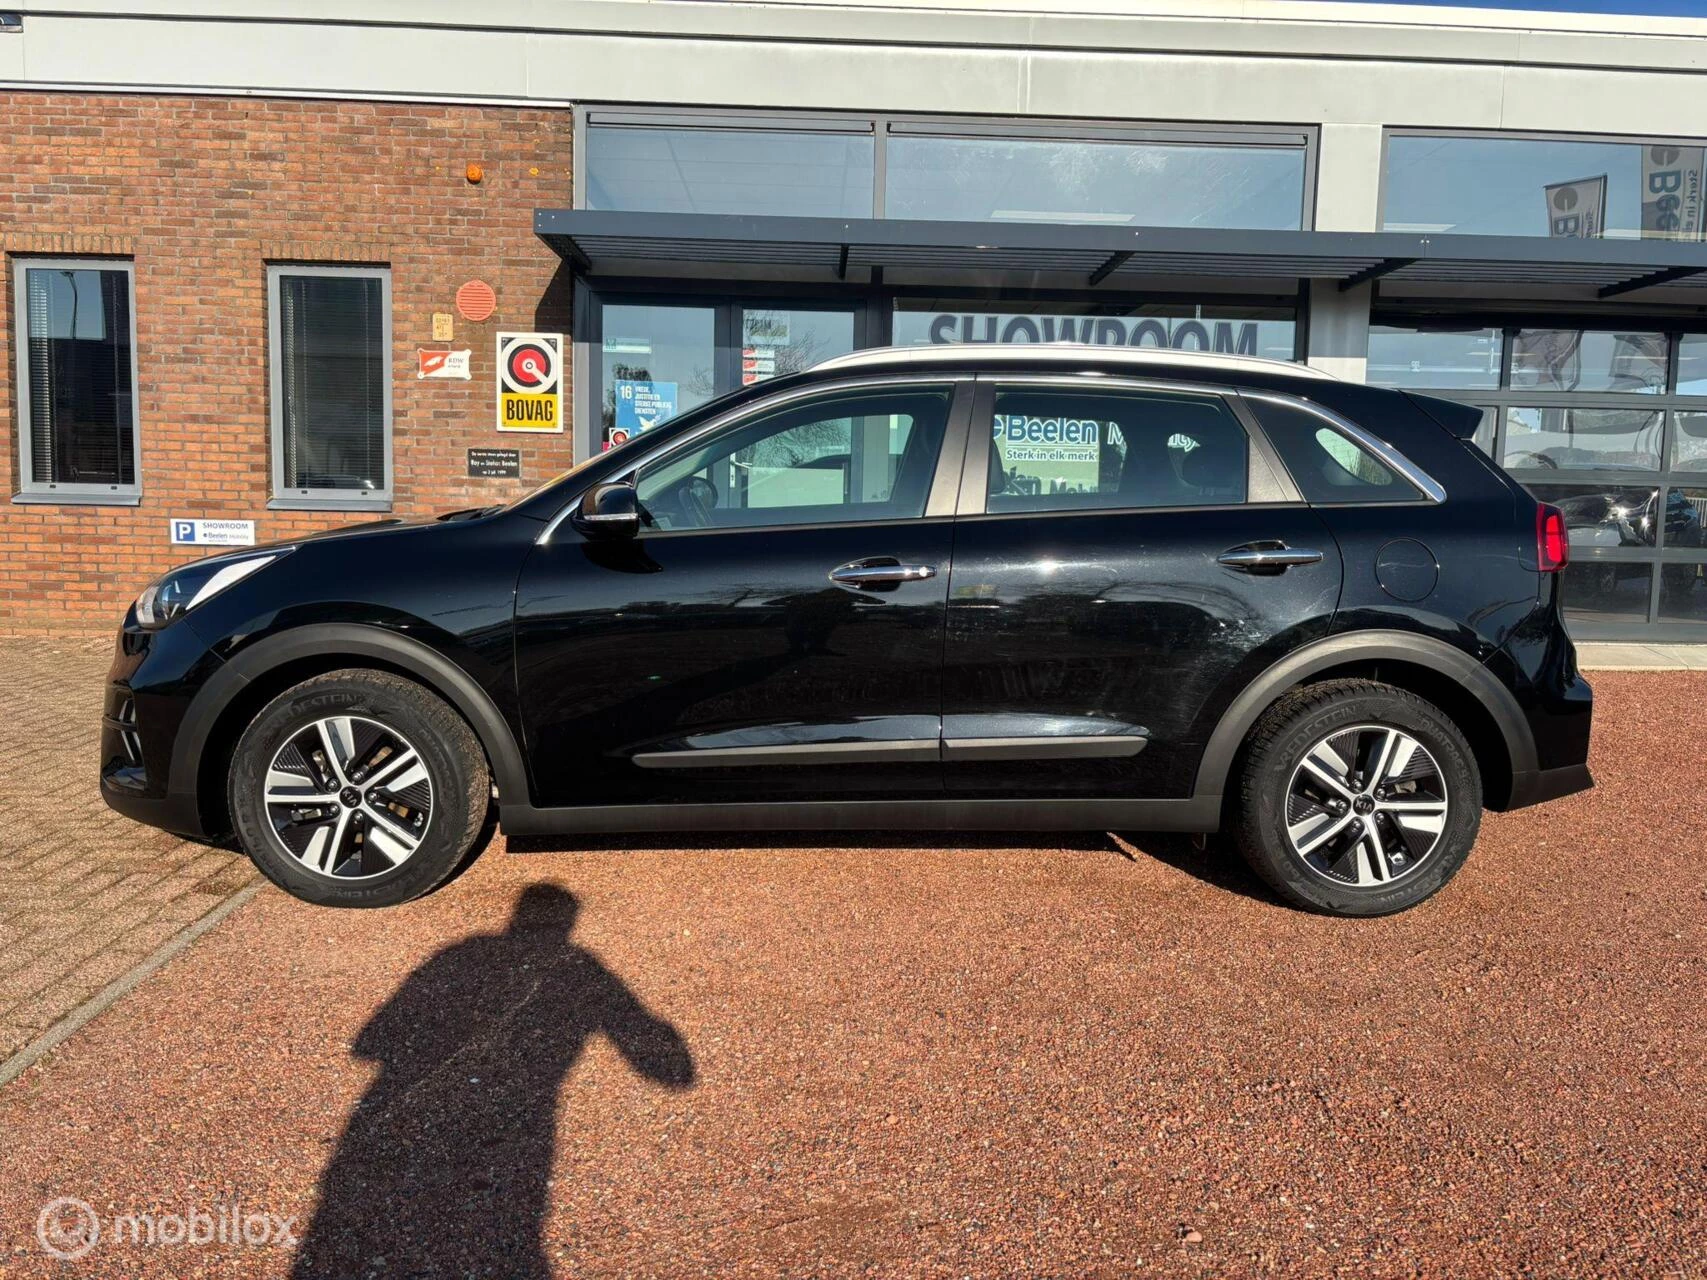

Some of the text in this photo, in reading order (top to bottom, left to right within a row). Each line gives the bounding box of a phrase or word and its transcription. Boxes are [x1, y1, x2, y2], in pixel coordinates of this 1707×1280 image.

[928, 313, 1258, 356] SHOWROOM
[620, 385, 632, 399] 16
[506, 399, 553, 421] BOVAG
[1006, 415, 1098, 444] Beelen
[1007, 449, 1095, 461] Sterk in elk merk
[179, 524, 191, 540] P
[1355, 799, 1372, 811] KIA
